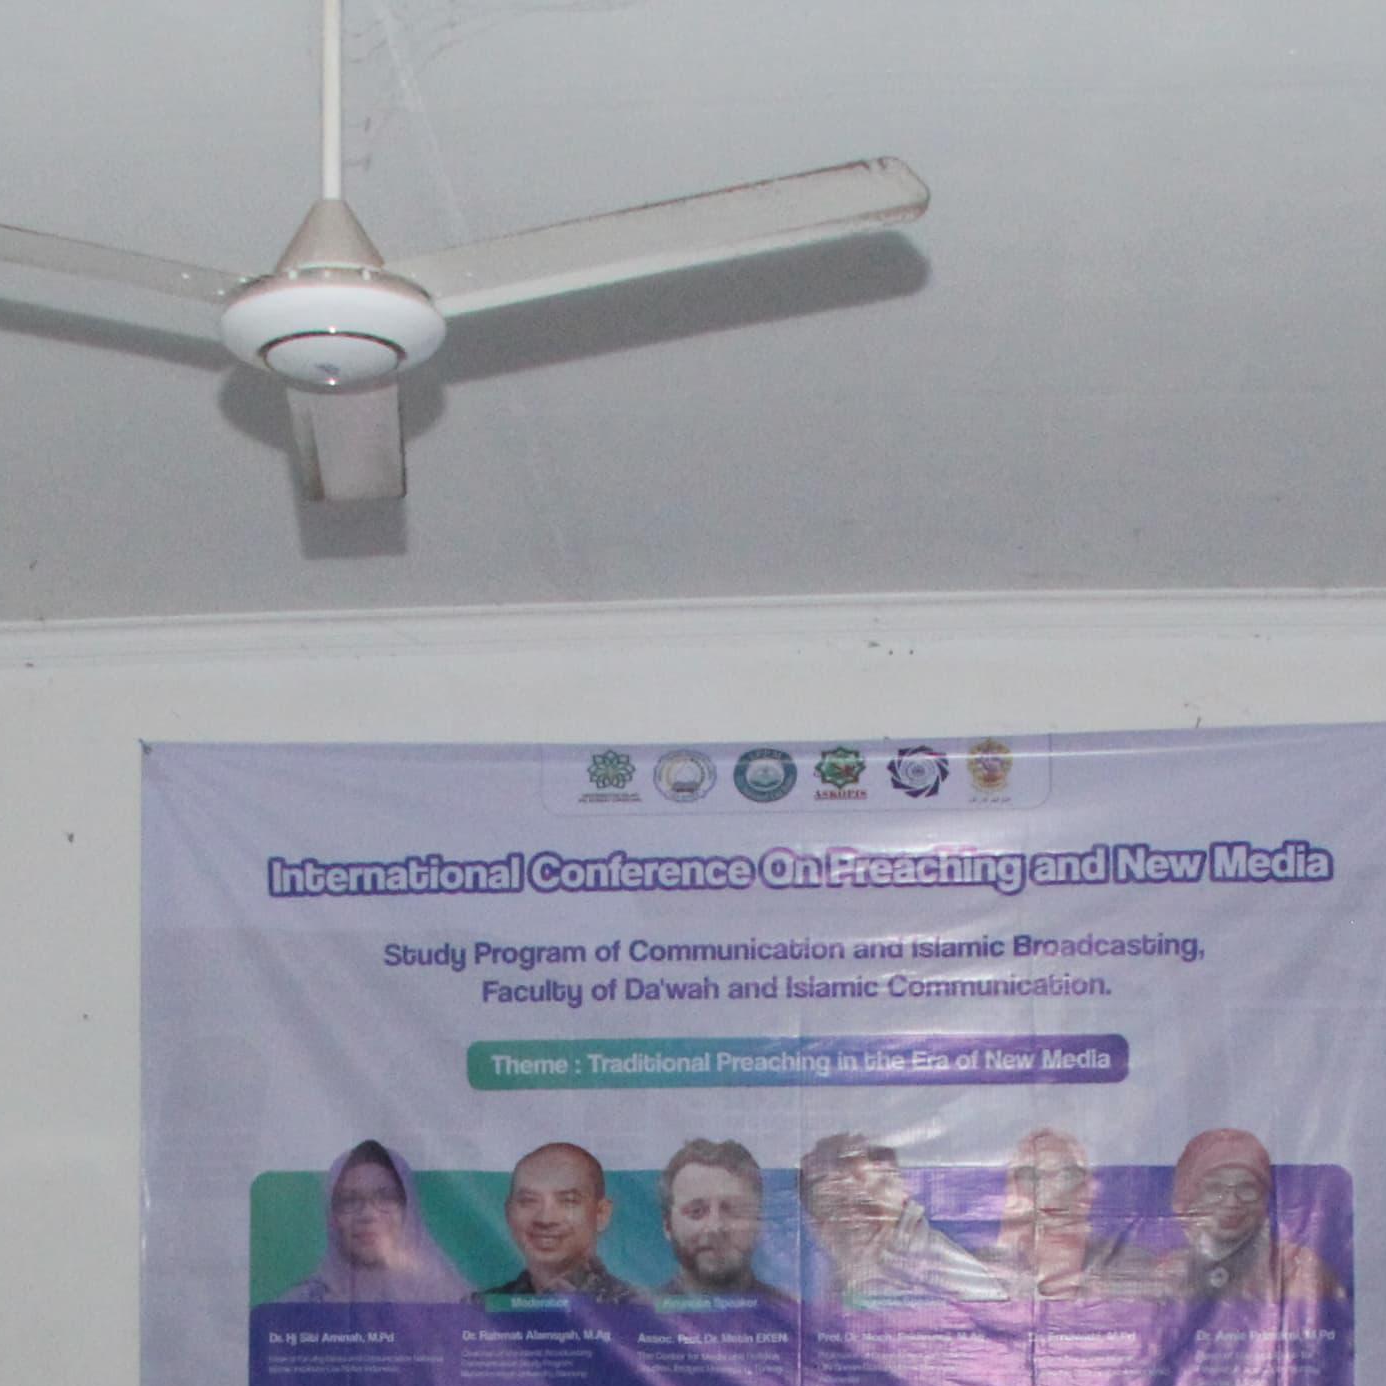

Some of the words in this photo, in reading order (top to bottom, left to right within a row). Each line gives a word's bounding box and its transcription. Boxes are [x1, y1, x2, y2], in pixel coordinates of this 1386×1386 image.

[270, 852, 521, 897] International
[528, 851, 754, 893] Conference
[759, 847, 822, 889] On
[826, 847, 1026, 896] Preaching
[1030, 844, 1109, 885] and
[1114, 845, 1207, 882] New
[1209, 840, 1333, 883] Media
[383, 942, 467, 972] Study
[474, 941, 587, 970] Program
[595, 939, 621, 963] of
[628, 936, 845, 963] Communication
[853, 936, 903, 960] and
[912, 935, 1006, 959] Islamic
[1013, 933, 1206, 963] Broadcasting,
[482, 978, 583, 1009] Faculty
[592, 976, 617, 1002] of
[624, 975, 719, 1001] Da'wah
[727, 975, 779, 1000] and
[784, 974, 879, 999] Islamic
[887, 973, 1112, 999] Communication.
[491, 1052, 569, 1075] Theme
[587, 1051, 711, 1074] Traditional
[716, 1050, 832, 1078] Preaching
[837, 1050, 859, 1072] in
[864, 1050, 906, 1072] the
[911, 1050, 950, 1071] Era
[955, 1048, 979, 1070] of
[984, 1049, 1035, 1071] New
[1042, 1048, 1112, 1070] Media
[756, 1332, 789, 1344] EKEN
